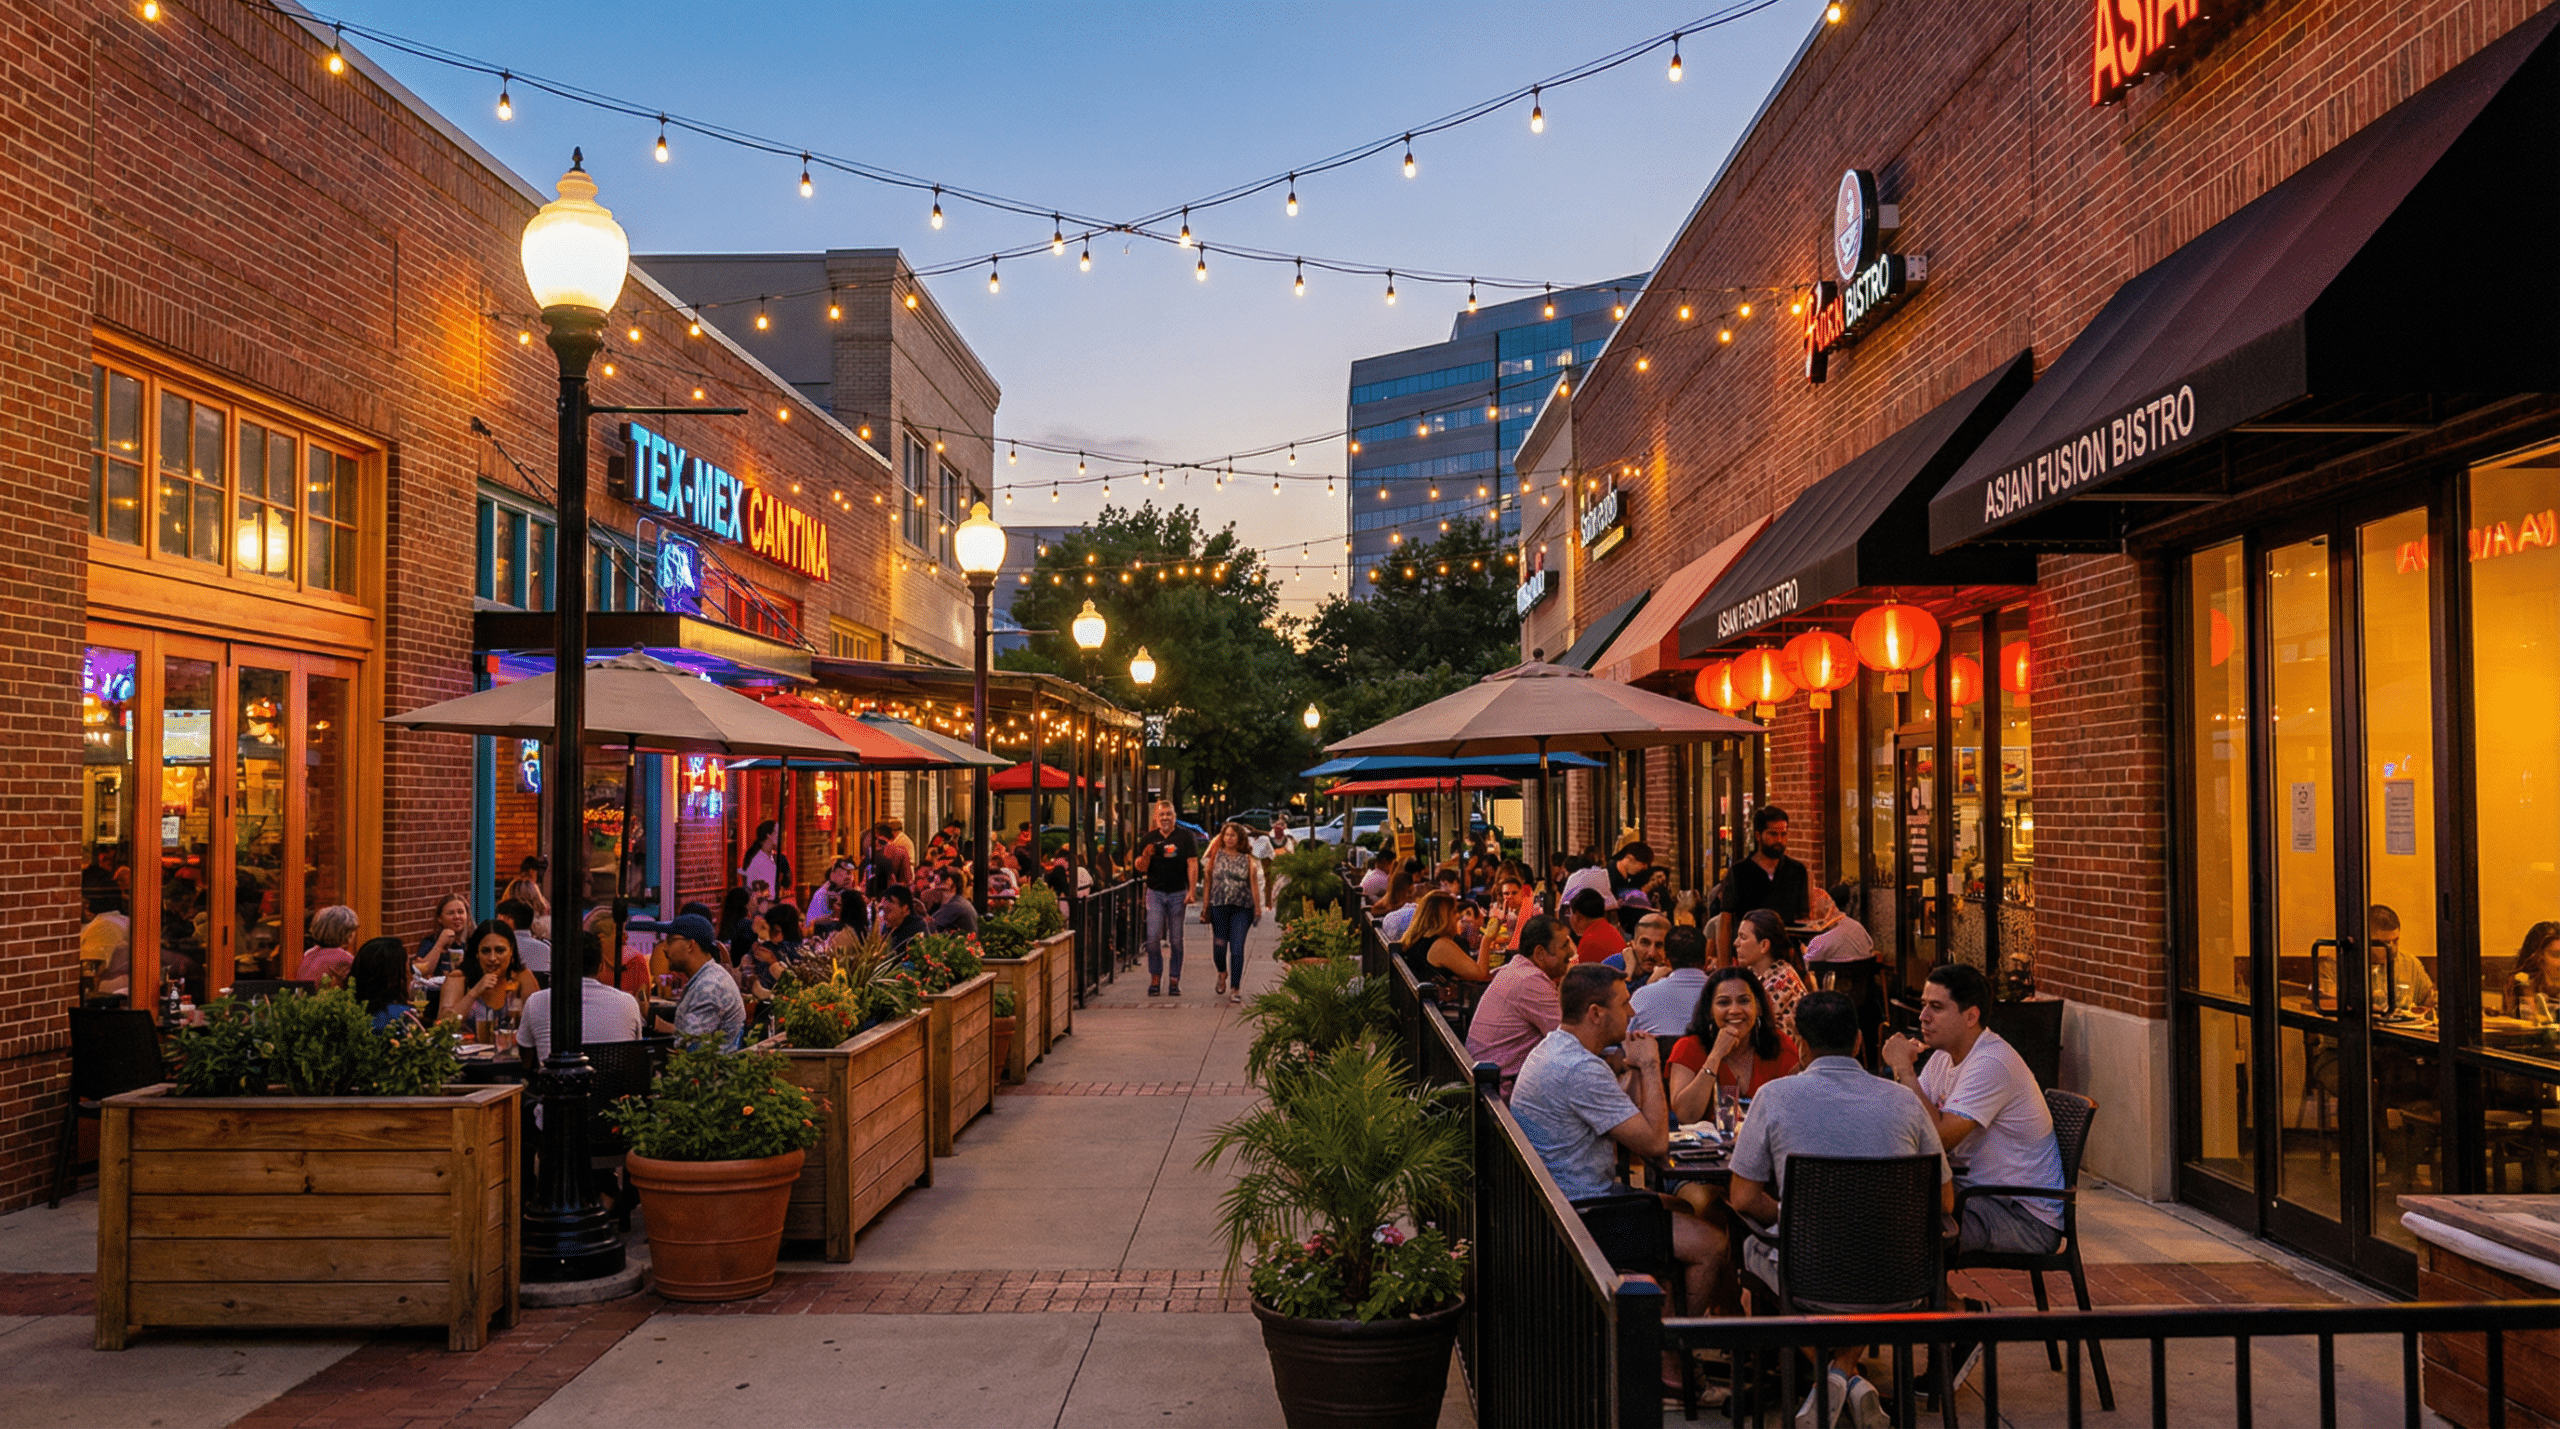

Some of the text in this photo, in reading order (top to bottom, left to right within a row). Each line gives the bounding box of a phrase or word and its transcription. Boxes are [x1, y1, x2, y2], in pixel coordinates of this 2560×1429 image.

[2090, 0, 2200, 109] ASI
[1845, 253, 1889, 328] BISTRO
[630, 421, 744, 544] TEX-MEX
[750, 486, 830, 583] CANTINA
[1984, 384, 2195, 524] ASIAN FUSION BISTRO
[1717, 577, 1798, 639] ASIAN FUSION BISTRO
